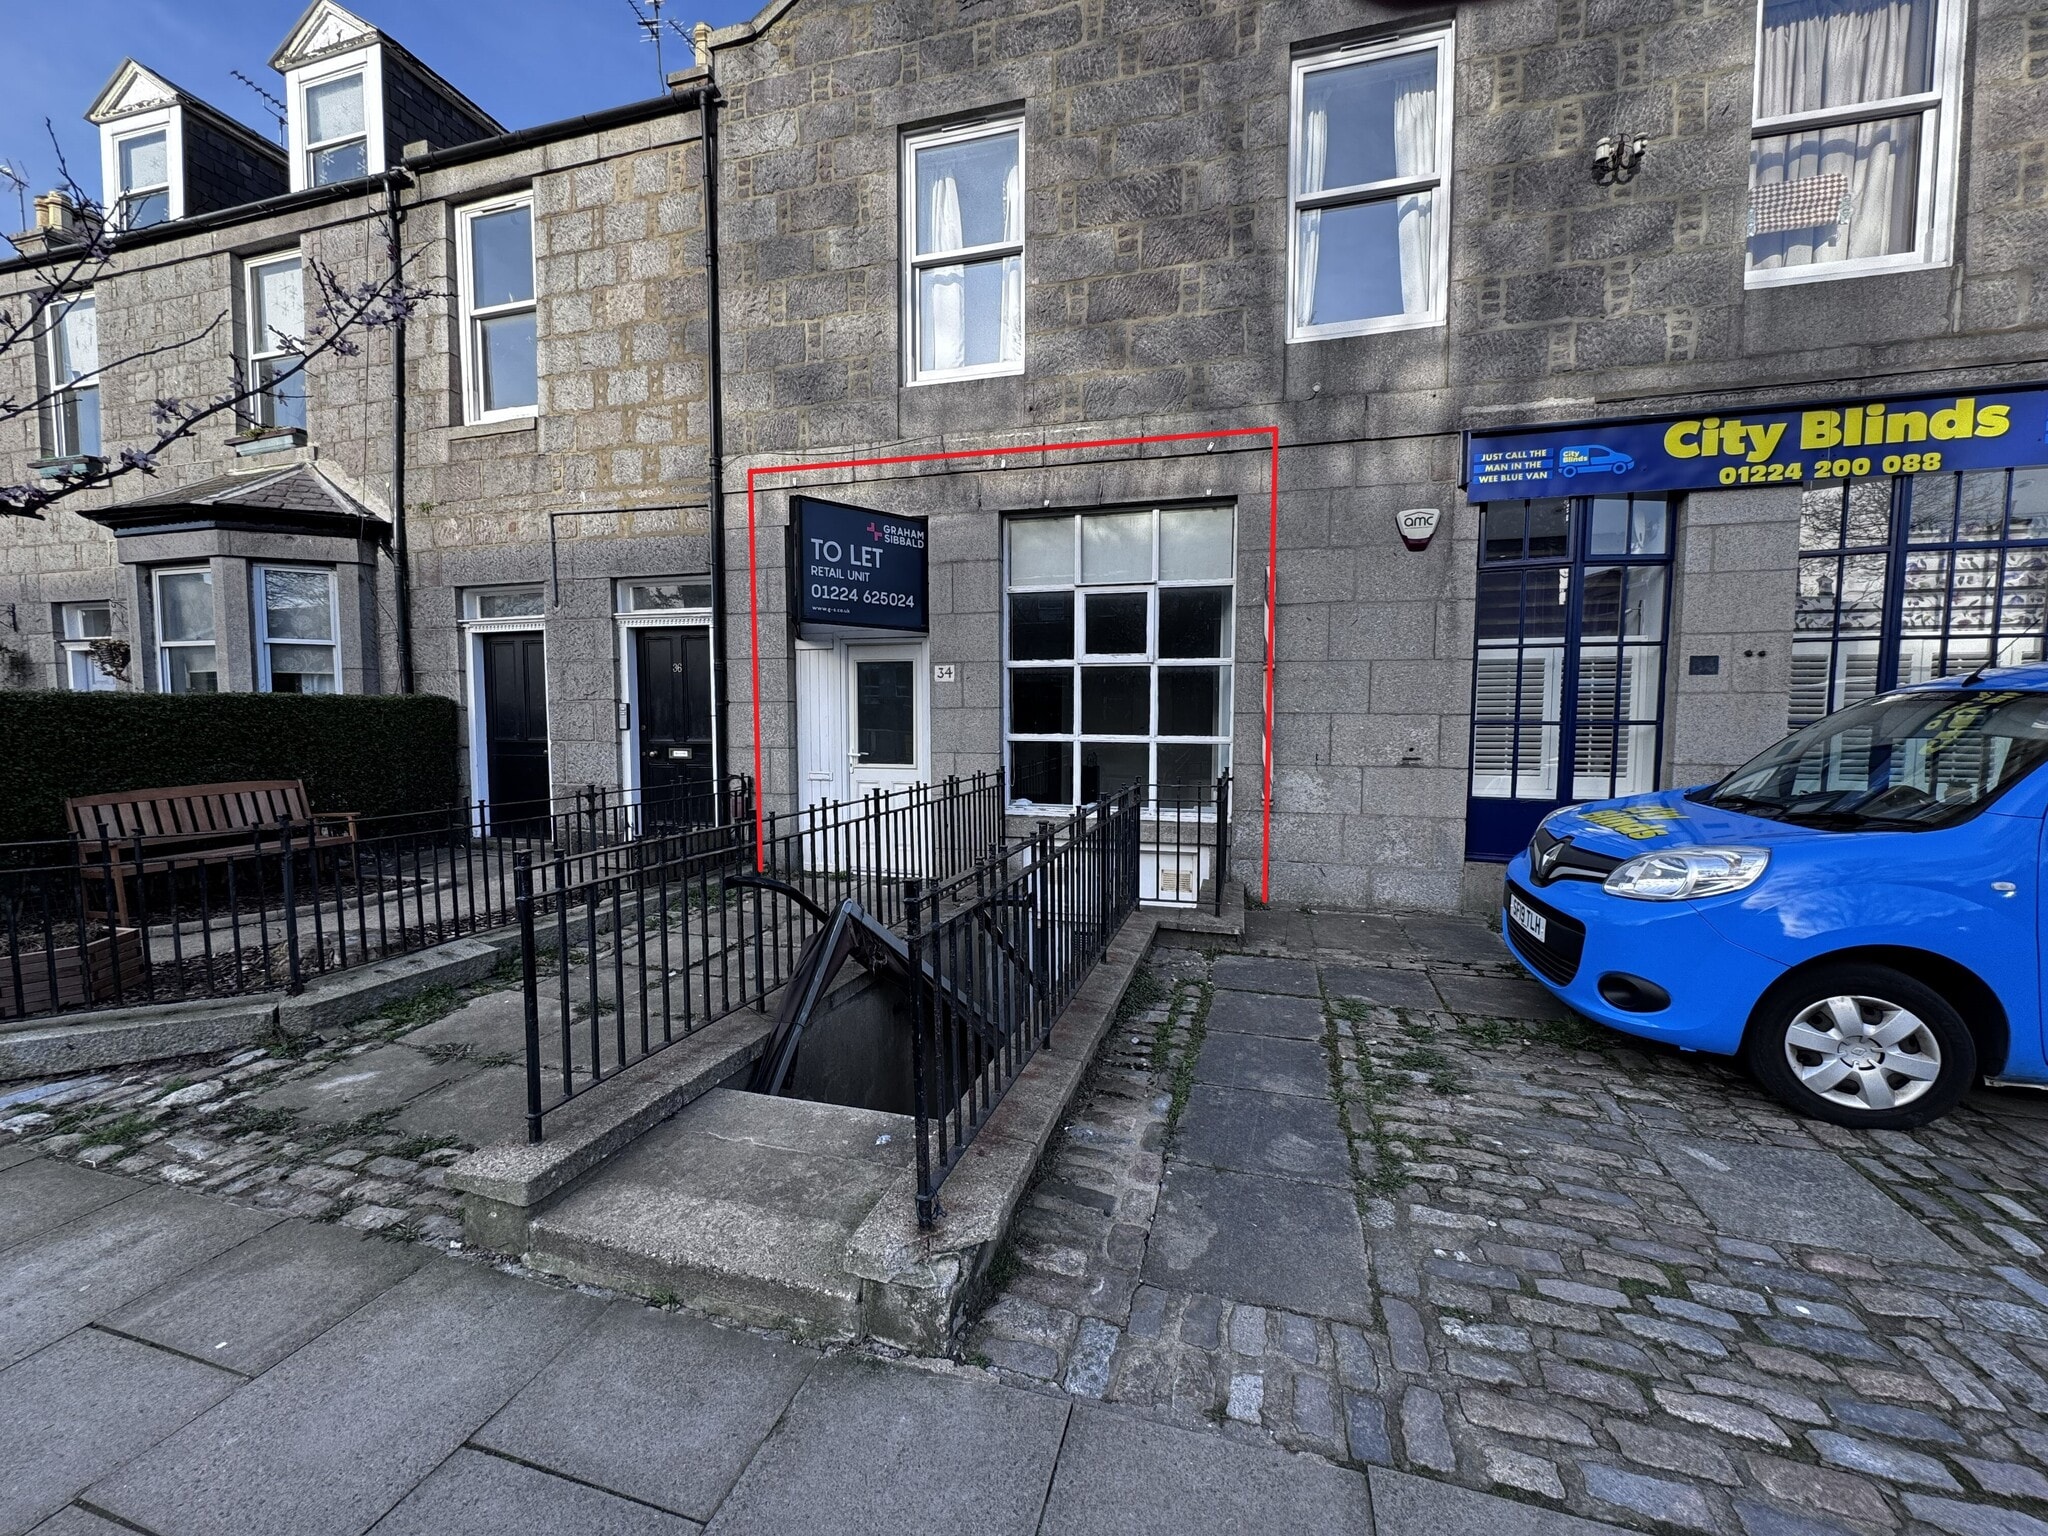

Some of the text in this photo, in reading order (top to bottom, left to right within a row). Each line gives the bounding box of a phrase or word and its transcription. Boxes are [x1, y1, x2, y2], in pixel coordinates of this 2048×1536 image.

[1664, 398, 2011, 463] City Blinds
[1481, 449, 1547, 462] JUST CALL THE
[1562, 450, 1580, 458] City
[1562, 455, 1588, 463] Blinds
[1484, 463, 1508, 472] MAN
[1525, 460, 1542, 469] THE
[1718, 452, 1942, 485] 01224 200 088
[1478, 471, 1548, 484] WEE BLUE VAN
[1404, 516, 1434, 527] amc
[883, 524, 925, 540] GRAHAM
[884, 534, 925, 549] SIBBALD
[810, 538, 884, 569] TO LET
[811, 565, 871, 582] RETAIL UNIT
[811, 583, 915, 608] 01224 625024
[672, 662, 683, 673] 36
[937, 666, 953, 679] 34
